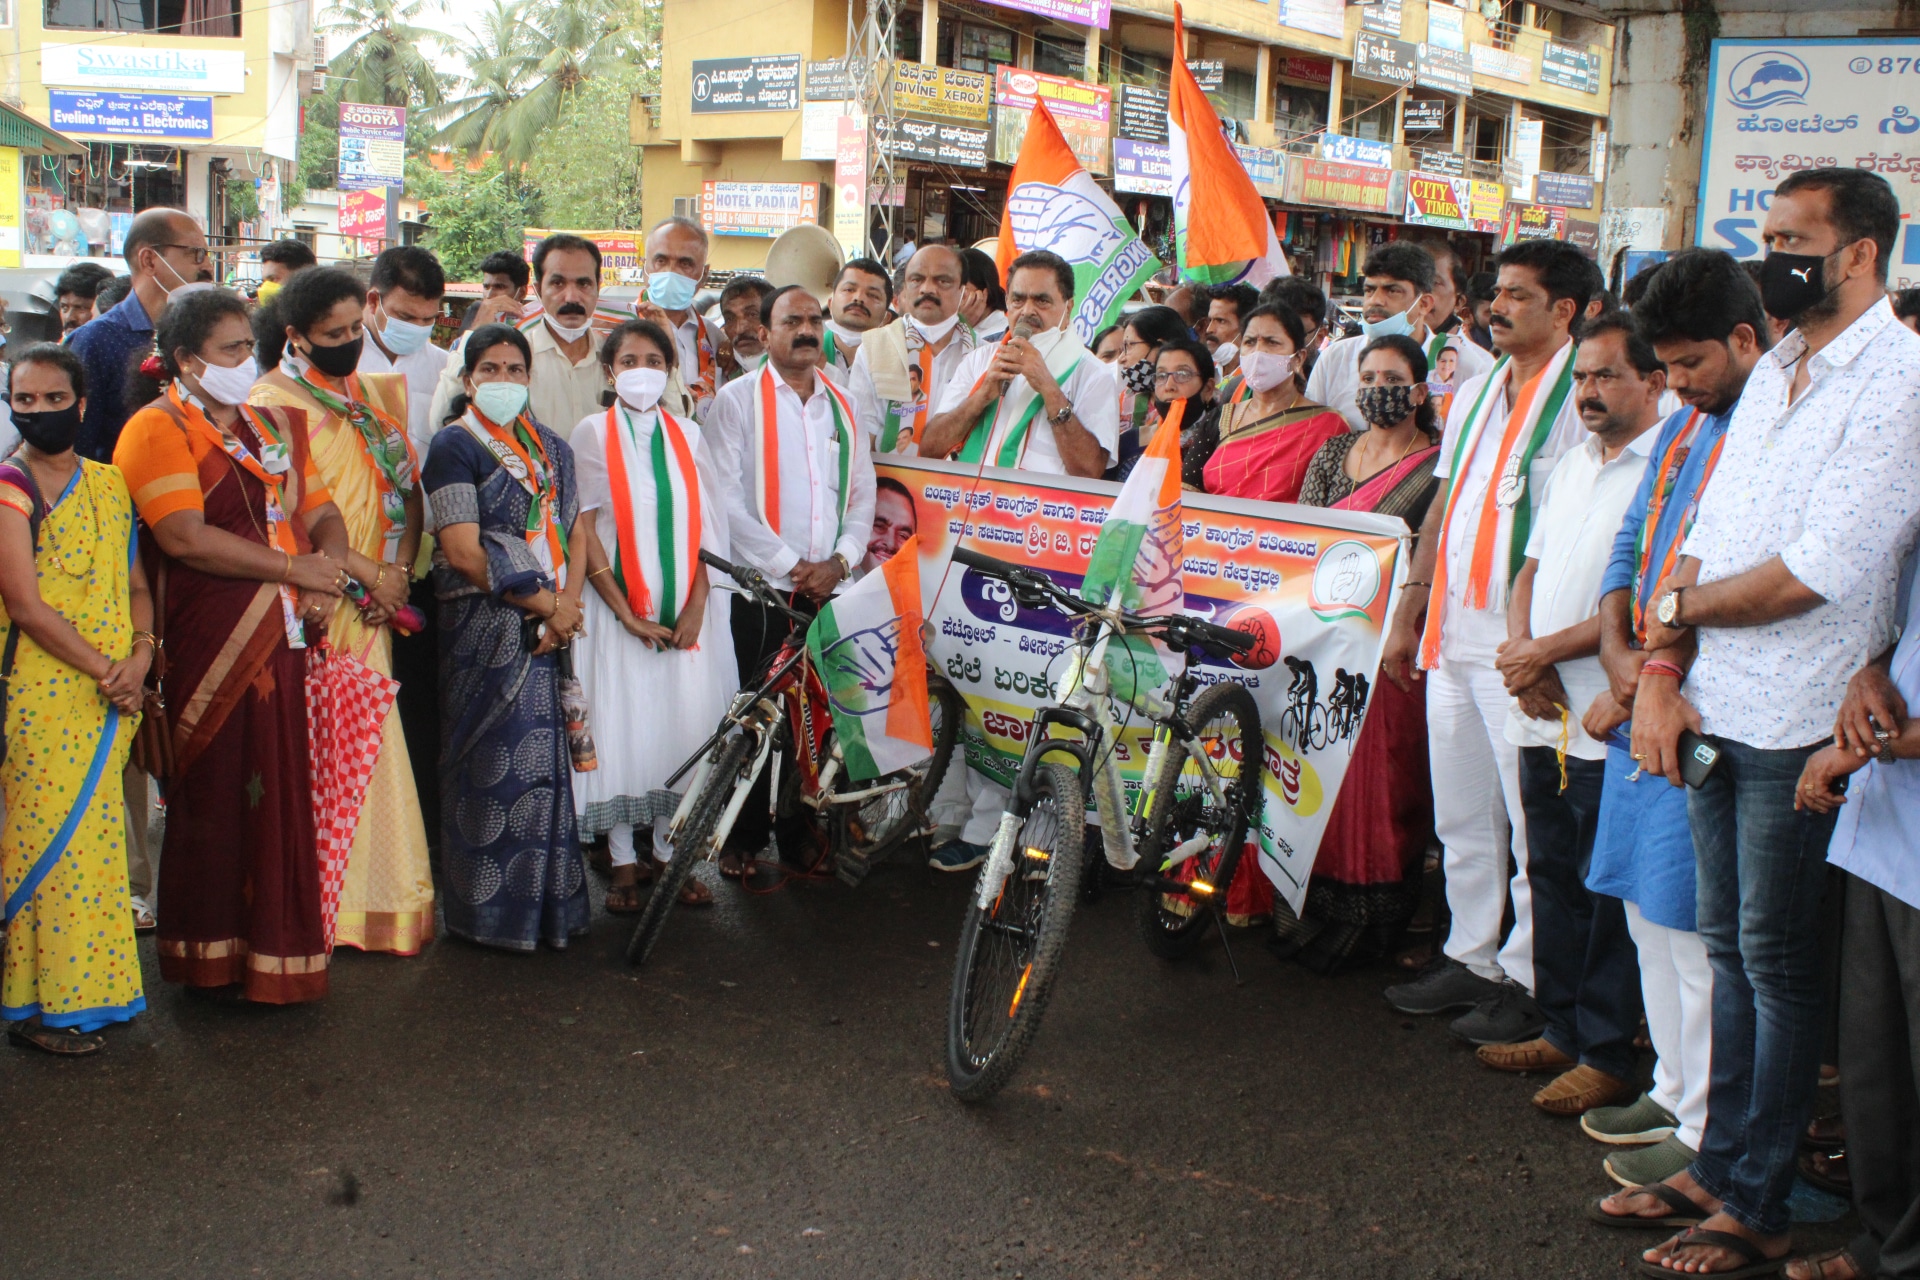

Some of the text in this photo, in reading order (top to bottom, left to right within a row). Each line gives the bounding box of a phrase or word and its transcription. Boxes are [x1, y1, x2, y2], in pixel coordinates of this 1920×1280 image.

[1074, 6, 1090, 17] PARTS
[77, 47, 207, 71] Swastika
[1369, 46, 1396, 63] SMILE
[1380, 64, 1413, 81] SALOON
[758, 88, 788, 102] ನೋಟರಿ
[894, 81, 984, 104] DIVINE XEROX
[54, 109, 209, 130] Eveline Traders & Electronics
[342, 113, 400, 127] SOORYA
[1736, 113, 1858, 134] ಹೋಟೆಲ್
[341, 126, 403, 138] Mobile Service Center
[1118, 157, 1172, 176] SHIV ELECTRI
[1734, 153, 1838, 180] ಫ್ಯಾಮಿಲಿ
[716, 194, 751, 207] HOTEL
[1325, 181, 1361, 203] MATCHING
[1412, 179, 1449, 201] CITY
[703, 182, 714, 232] LODGE
[800, 185, 815, 226] BA
[1425, 199, 1459, 218] TIMES
[714, 211, 799, 227] BAR & FAMILY RESTAURANT
[741, 226, 772, 235] TOURIST
[924, 485, 960, 509] ಬಂಟ್ವಾಳ
[964, 491, 991, 511] ಬ್ಲಾಕ್
[996, 496, 1038, 518] ಕಾಂಗ್ರೆಸ್
[1042, 503, 1075, 519] ಹಾಗೂ
[1205, 527, 1254, 550] ಕಾಂಗ್ರೆಸ್
[1258, 535, 1317, 557] ವತಿಯಿಂದ
[948, 520, 973, 535] ಮಾಜಿ
[978, 524, 1024, 544] ಸಚಿವರಾದ
[1027, 524, 1047, 555] ಶ್ರೀ
[1055, 532, 1071, 552] ಬಿ.
[1183, 557, 1218, 576] ಯವರ
[1223, 562, 1280, 592] ನೇತೃತ್ವದಲ್ಲಿ
[942, 616, 996, 646] ಪೆಟ್ರೋಲ್
[1019, 635, 1066, 658] ಡೀಸಲ್
[947, 653, 982, 684] ಬೆಲೆ
